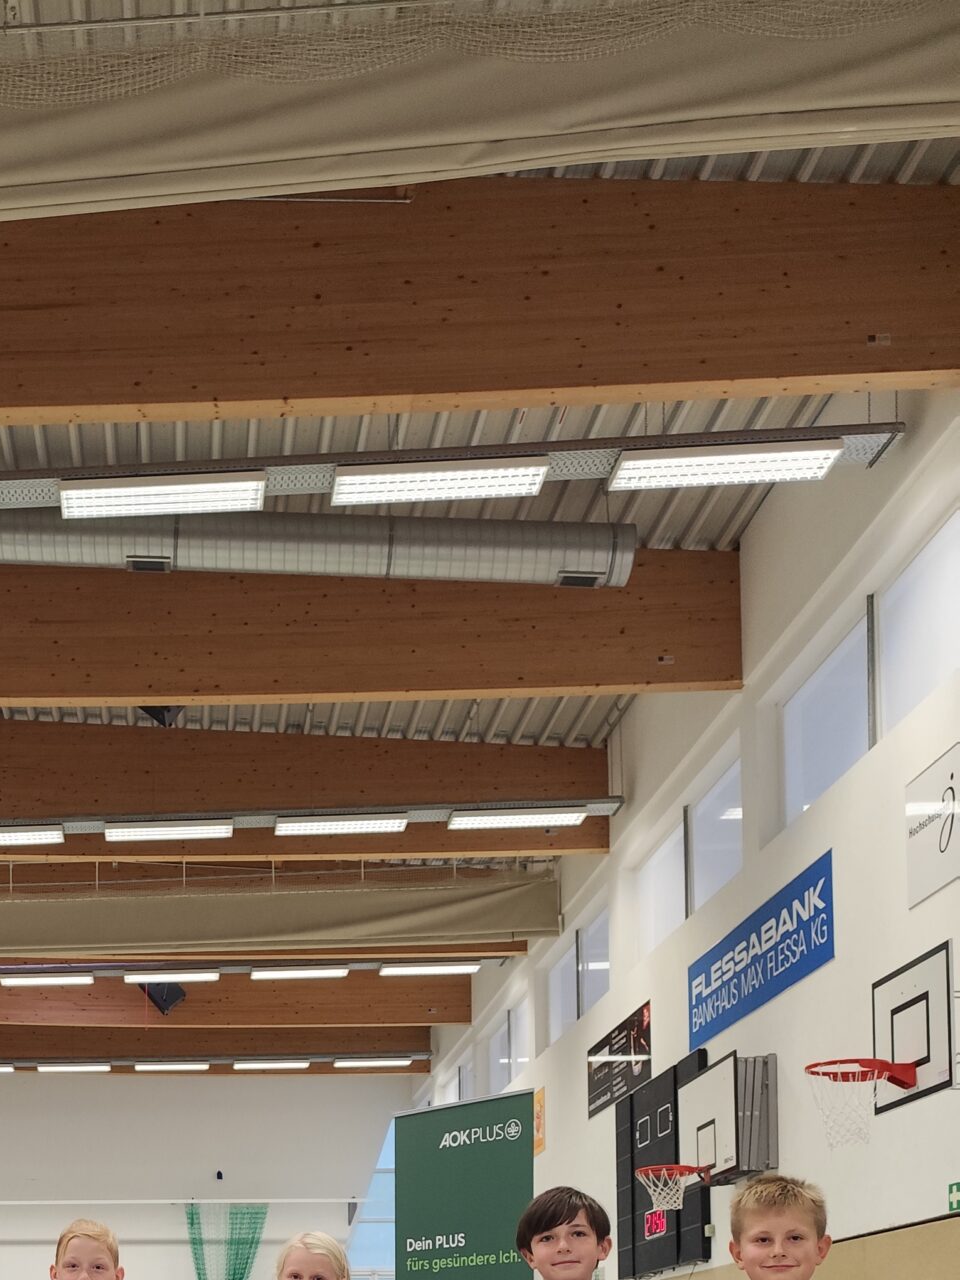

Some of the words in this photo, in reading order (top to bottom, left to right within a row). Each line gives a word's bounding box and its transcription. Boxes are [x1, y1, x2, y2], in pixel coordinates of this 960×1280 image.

[691, 877, 827, 1005] FLESSABANK
[692, 979, 738, 1033] BANKHAUS
[741, 961, 765, 999] MAX
[767, 930, 808, 980] FLESSA
[810, 913, 828, 950] KG
[406, 1236, 433, 1252] Dein
[436, 1233, 466, 1249] PLUS
[406, 1257, 430, 1271] fürs
[432, 1253, 497, 1273] gesündere
[499, 1249, 522, 1265] Ich.
